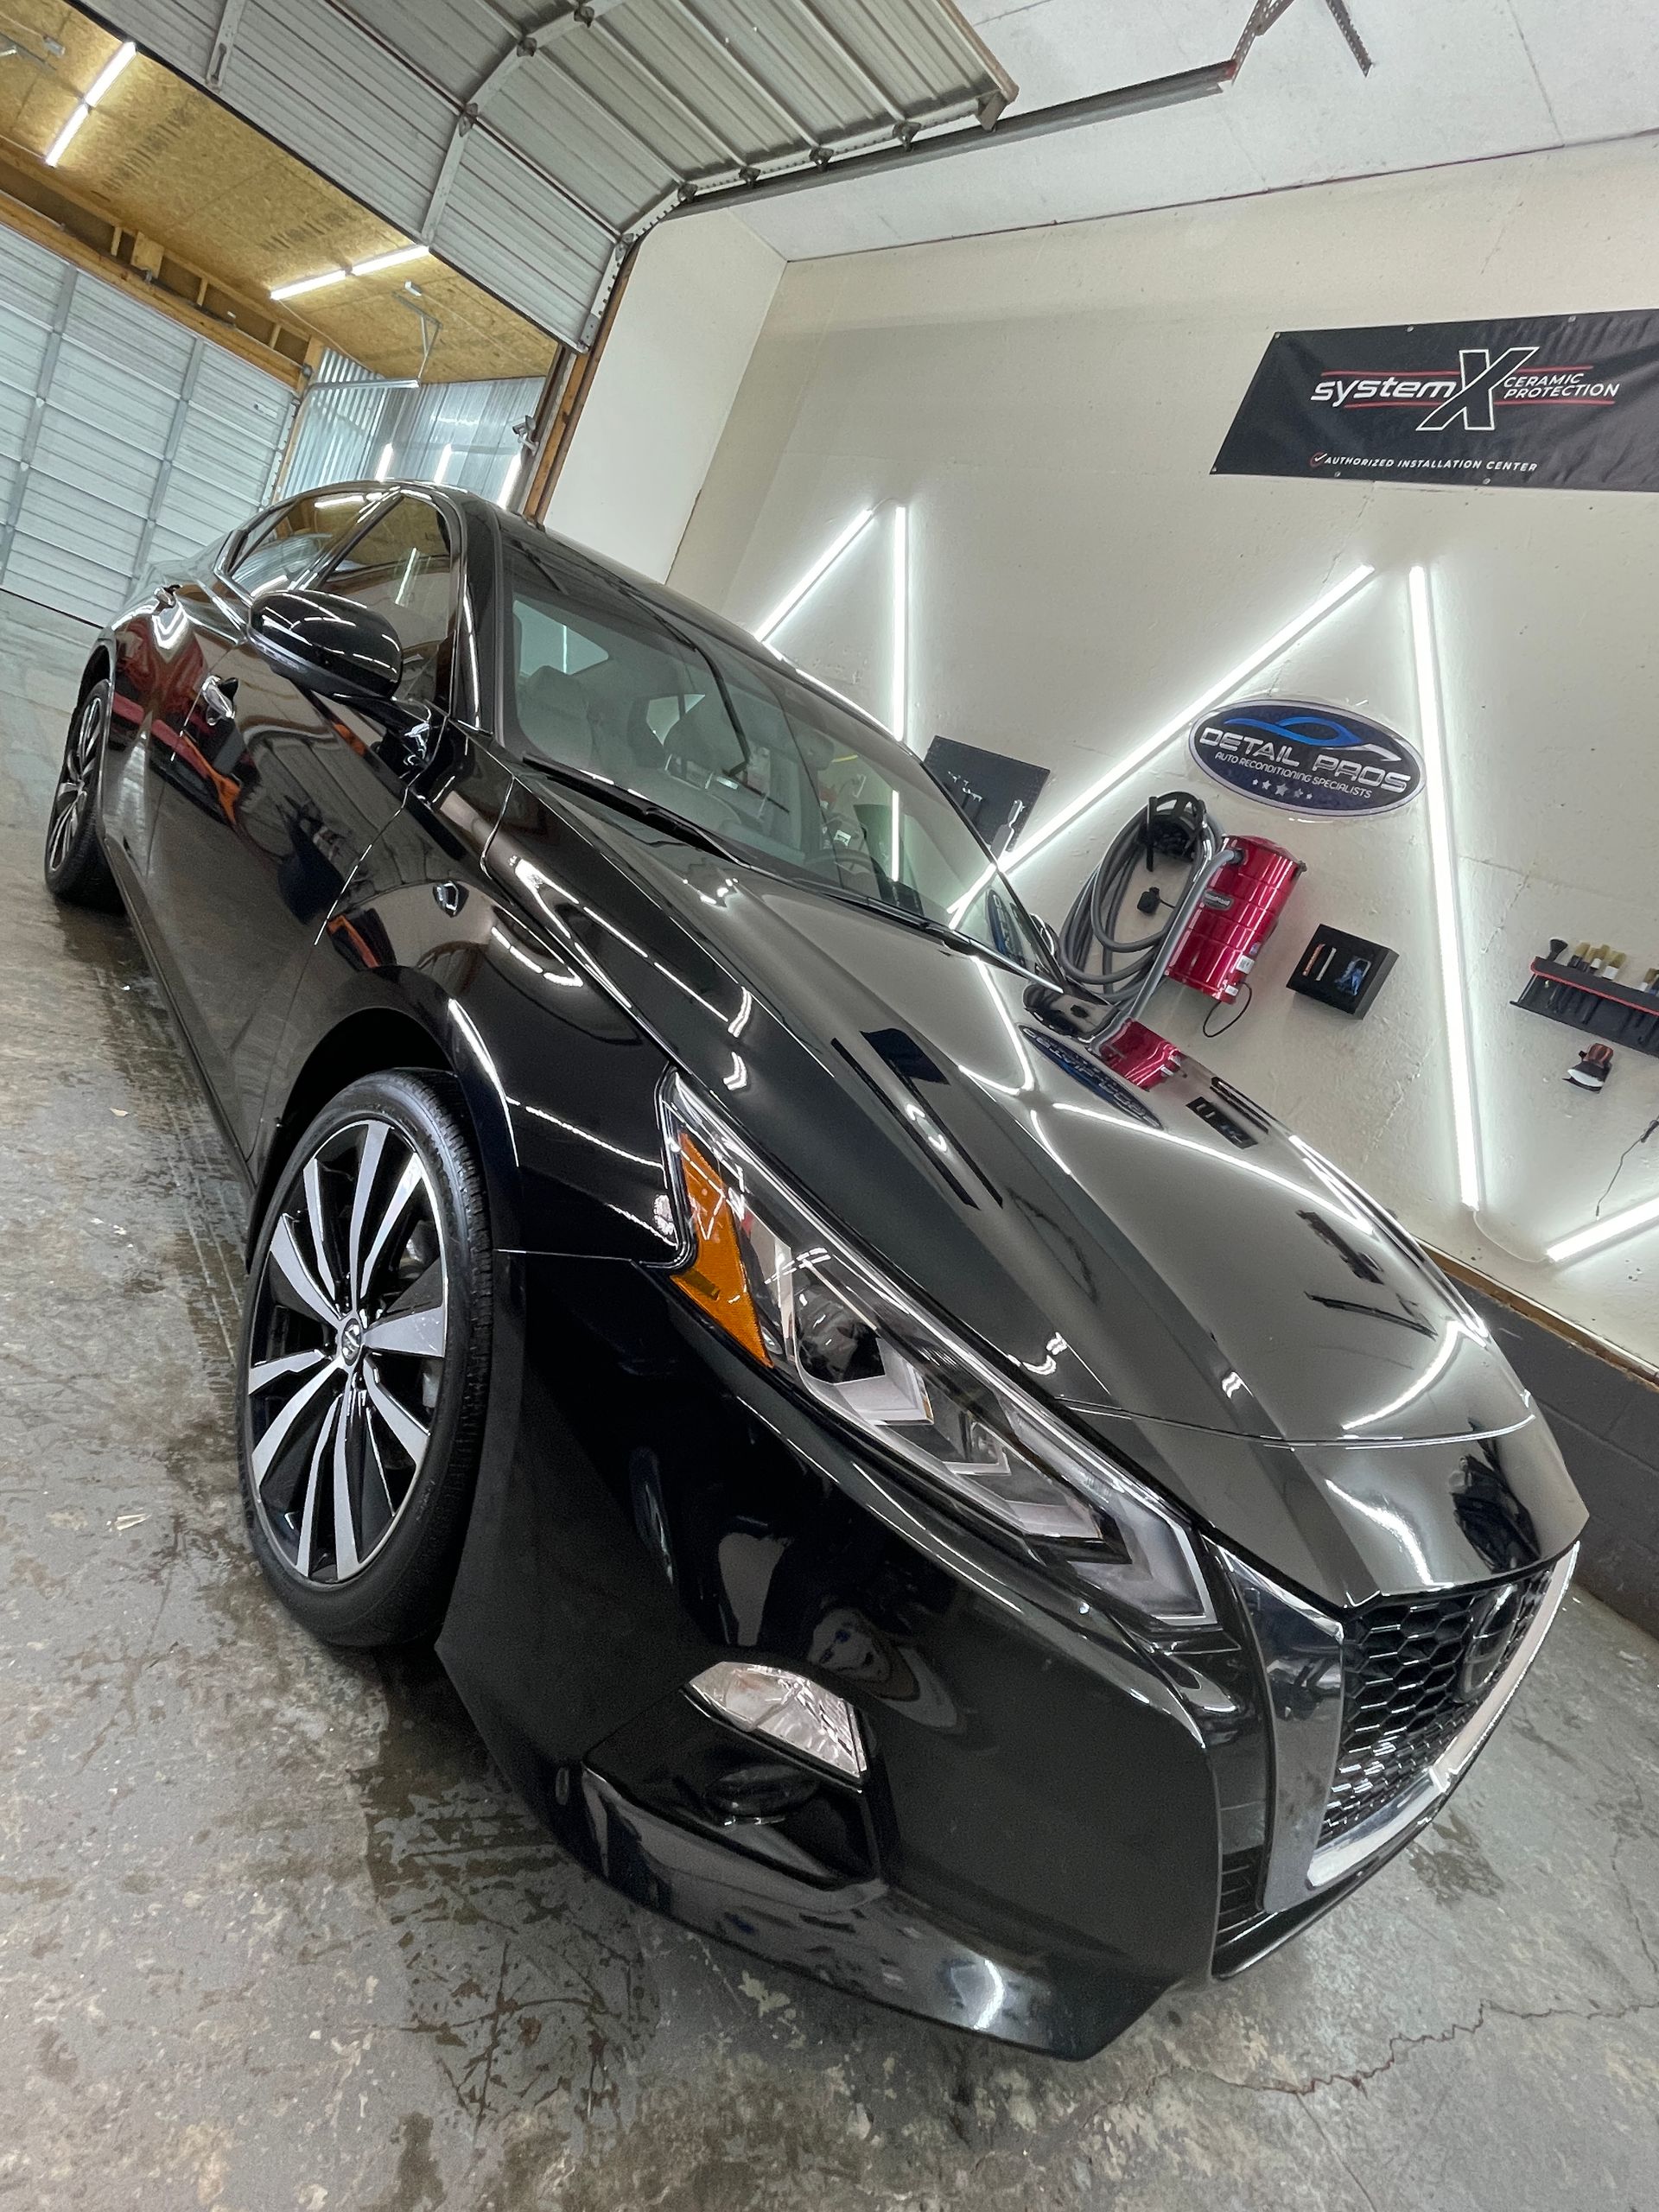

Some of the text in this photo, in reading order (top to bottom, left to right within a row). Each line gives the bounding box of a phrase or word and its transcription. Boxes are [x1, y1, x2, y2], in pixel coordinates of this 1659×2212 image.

[1503, 372, 1585, 388] CERAMIC
[1503, 383, 1620, 399] PROTECTION
[1324, 455, 1538, 473] AUTHORIZED INSTALLATION CENTER
[1199, 727, 1412, 793] DETAIL PROS
[1214, 751, 1239, 764] AUTO
[1312, 776, 1373, 798] SPECIALISTS
